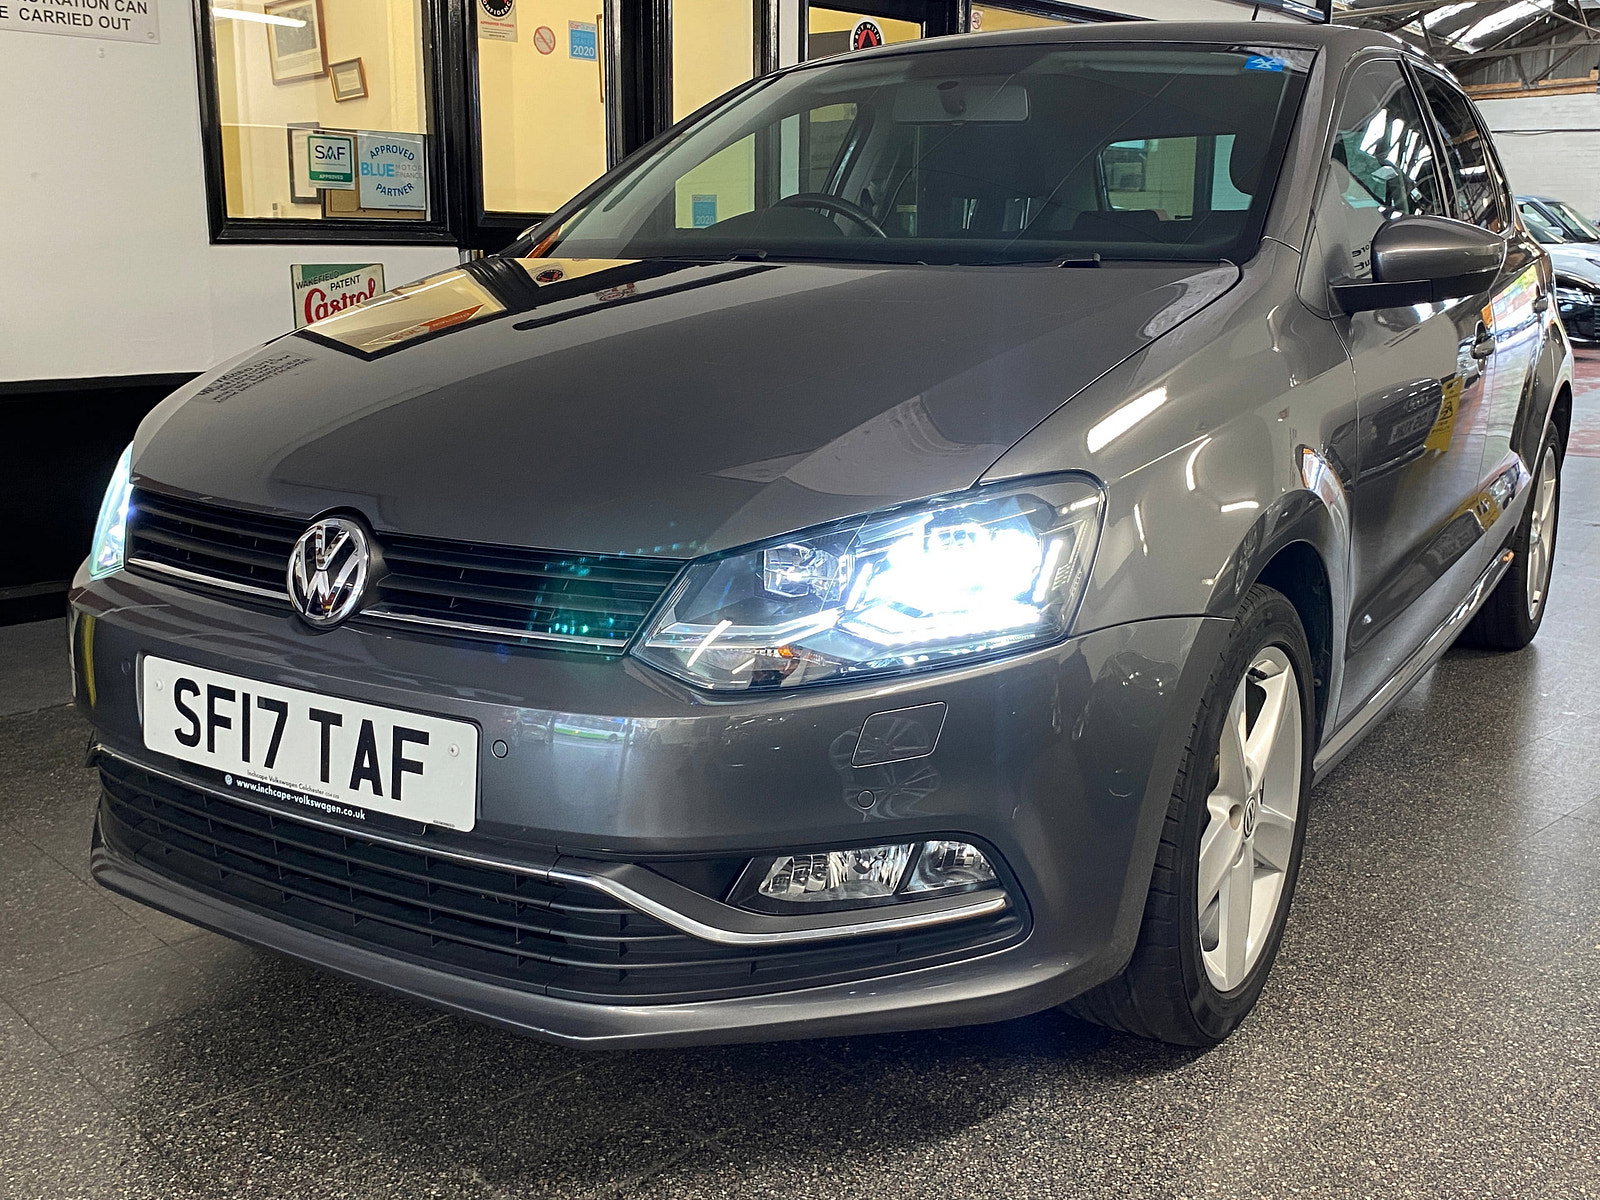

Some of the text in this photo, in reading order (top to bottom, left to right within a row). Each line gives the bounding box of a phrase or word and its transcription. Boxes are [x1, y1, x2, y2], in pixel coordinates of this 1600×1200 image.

[114, 0, 147, 14] CAN
[19, 7, 93, 27] CARRIED
[99, 16, 131, 30] OUT
[866, 23, 880, 40] WITH
[573, 45, 594, 57] 2020
[314, 145, 346, 160] SAF
[370, 144, 415, 161] APPROVED
[360, 161, 395, 177] BLUE
[375, 182, 414, 197] PARTNER
[296, 270, 340, 290] WAKEFIELD
[330, 274, 361, 292] PATENT
[304, 277, 376, 325] Castrol
[173, 677, 430, 801] SF17 TAF
[247, 769, 268, 781] Inchcape
[268, 774, 298, 789] Volkswagen
[235, 778, 366, 820] www.inchcape-volkswagen.co.uk
